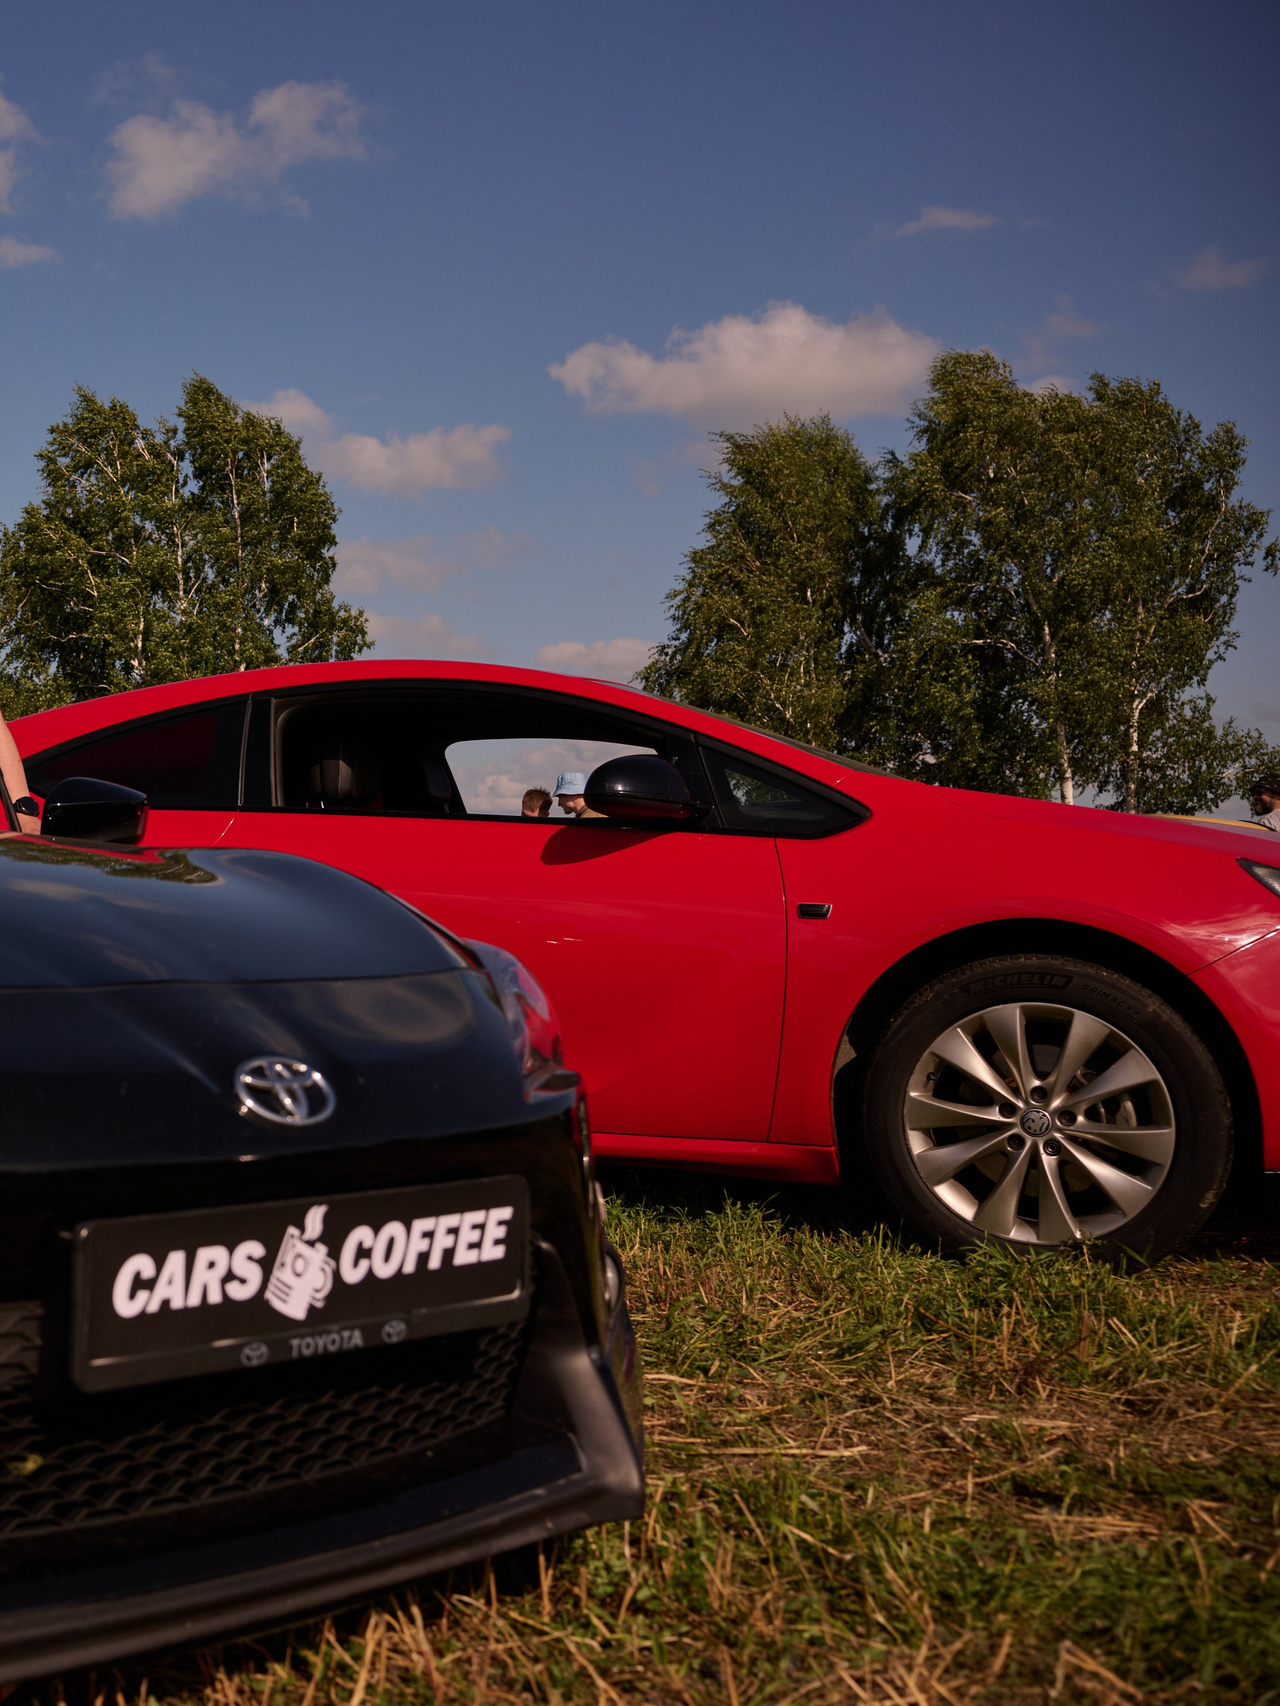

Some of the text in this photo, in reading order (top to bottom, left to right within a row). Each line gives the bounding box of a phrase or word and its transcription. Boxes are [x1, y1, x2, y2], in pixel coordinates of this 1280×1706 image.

[968, 973, 1069, 995] MICHELIN
[1080, 984, 1134, 1011] PRIMACY
[113, 1206, 514, 1319] CARS COFFEE
[289, 1329, 364, 1358] TOYOTA
